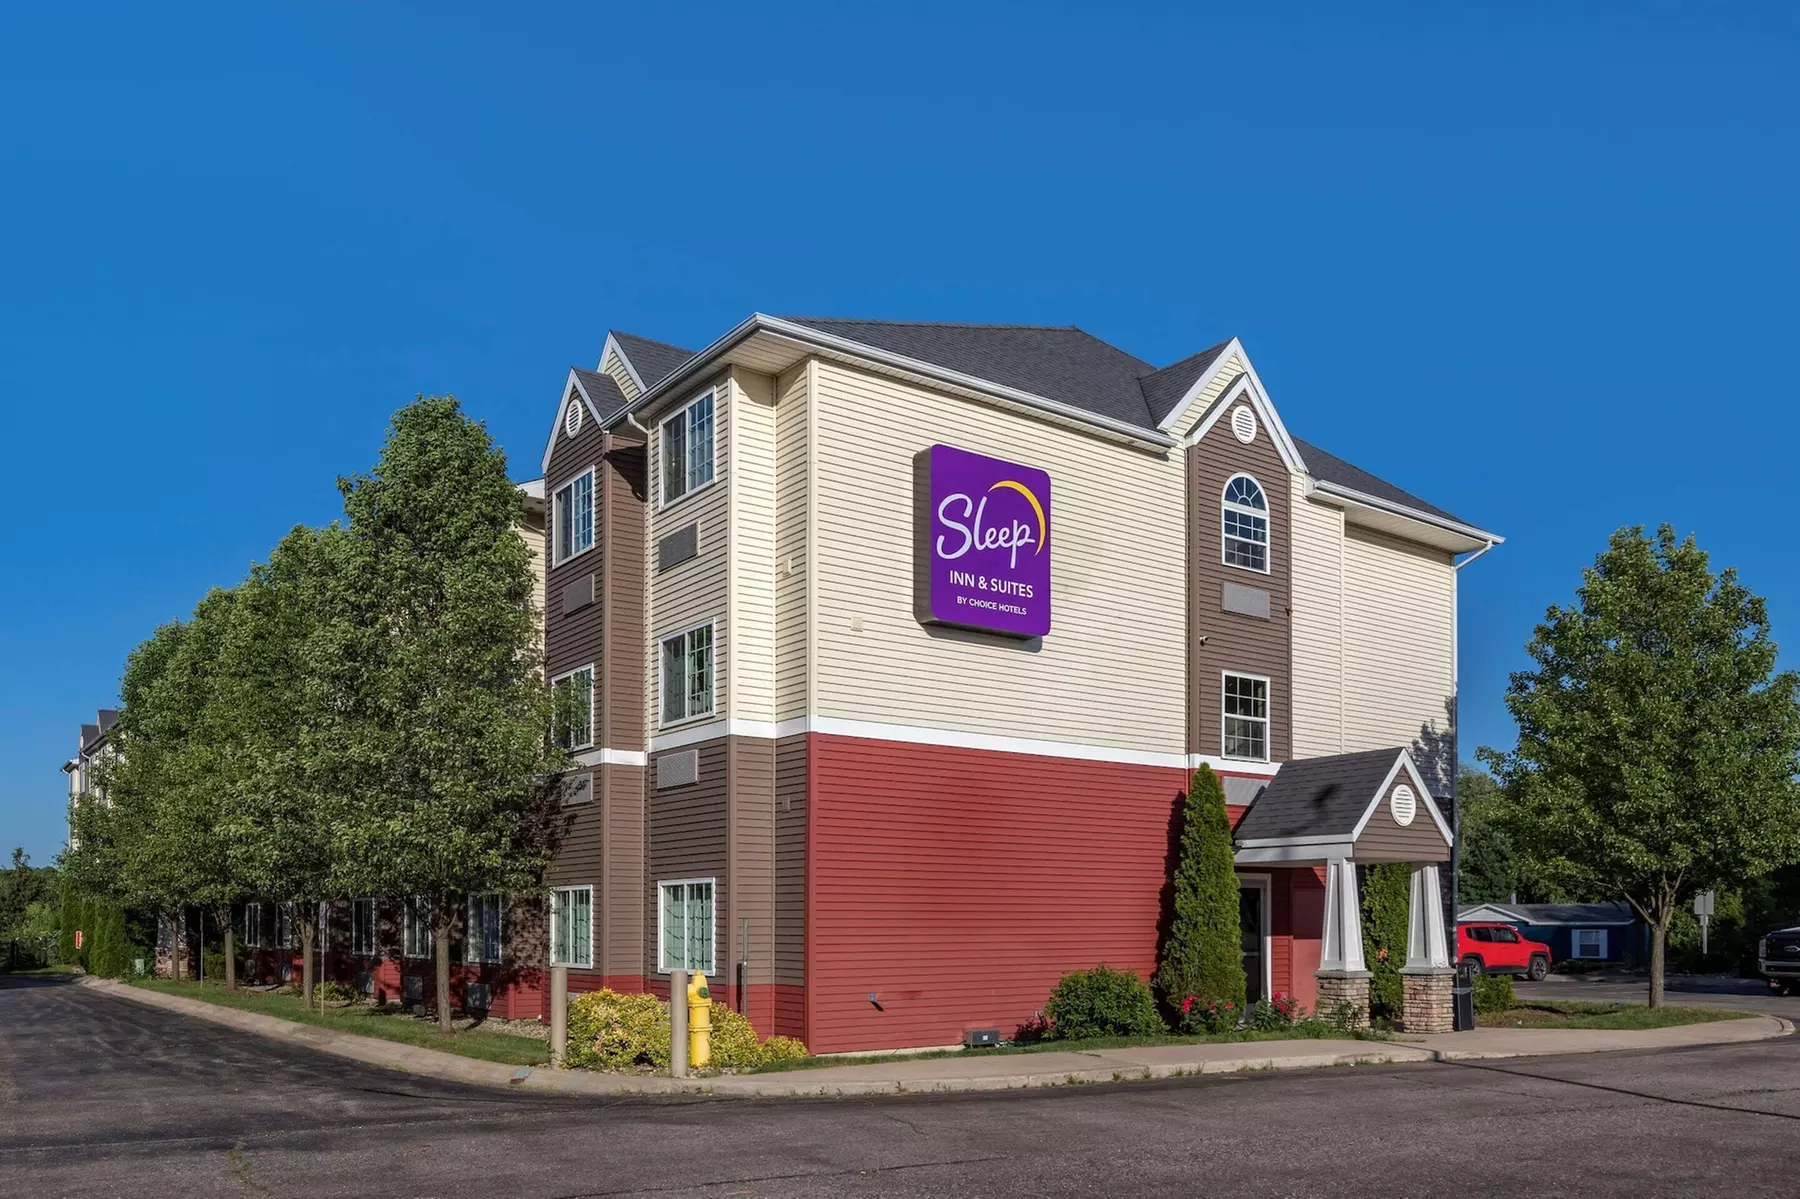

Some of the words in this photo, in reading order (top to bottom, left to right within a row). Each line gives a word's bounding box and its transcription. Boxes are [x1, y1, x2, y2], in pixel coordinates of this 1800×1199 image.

[936, 493, 1036, 569] Sleep
[950, 570, 975, 588] INN
[978, 576, 988, 590] &
[990, 578, 1034, 598] SUITES
[957, 596, 968, 605] BY
[969, 598, 998, 611] CHOICE
[999, 603, 1027, 616] HOTELS
